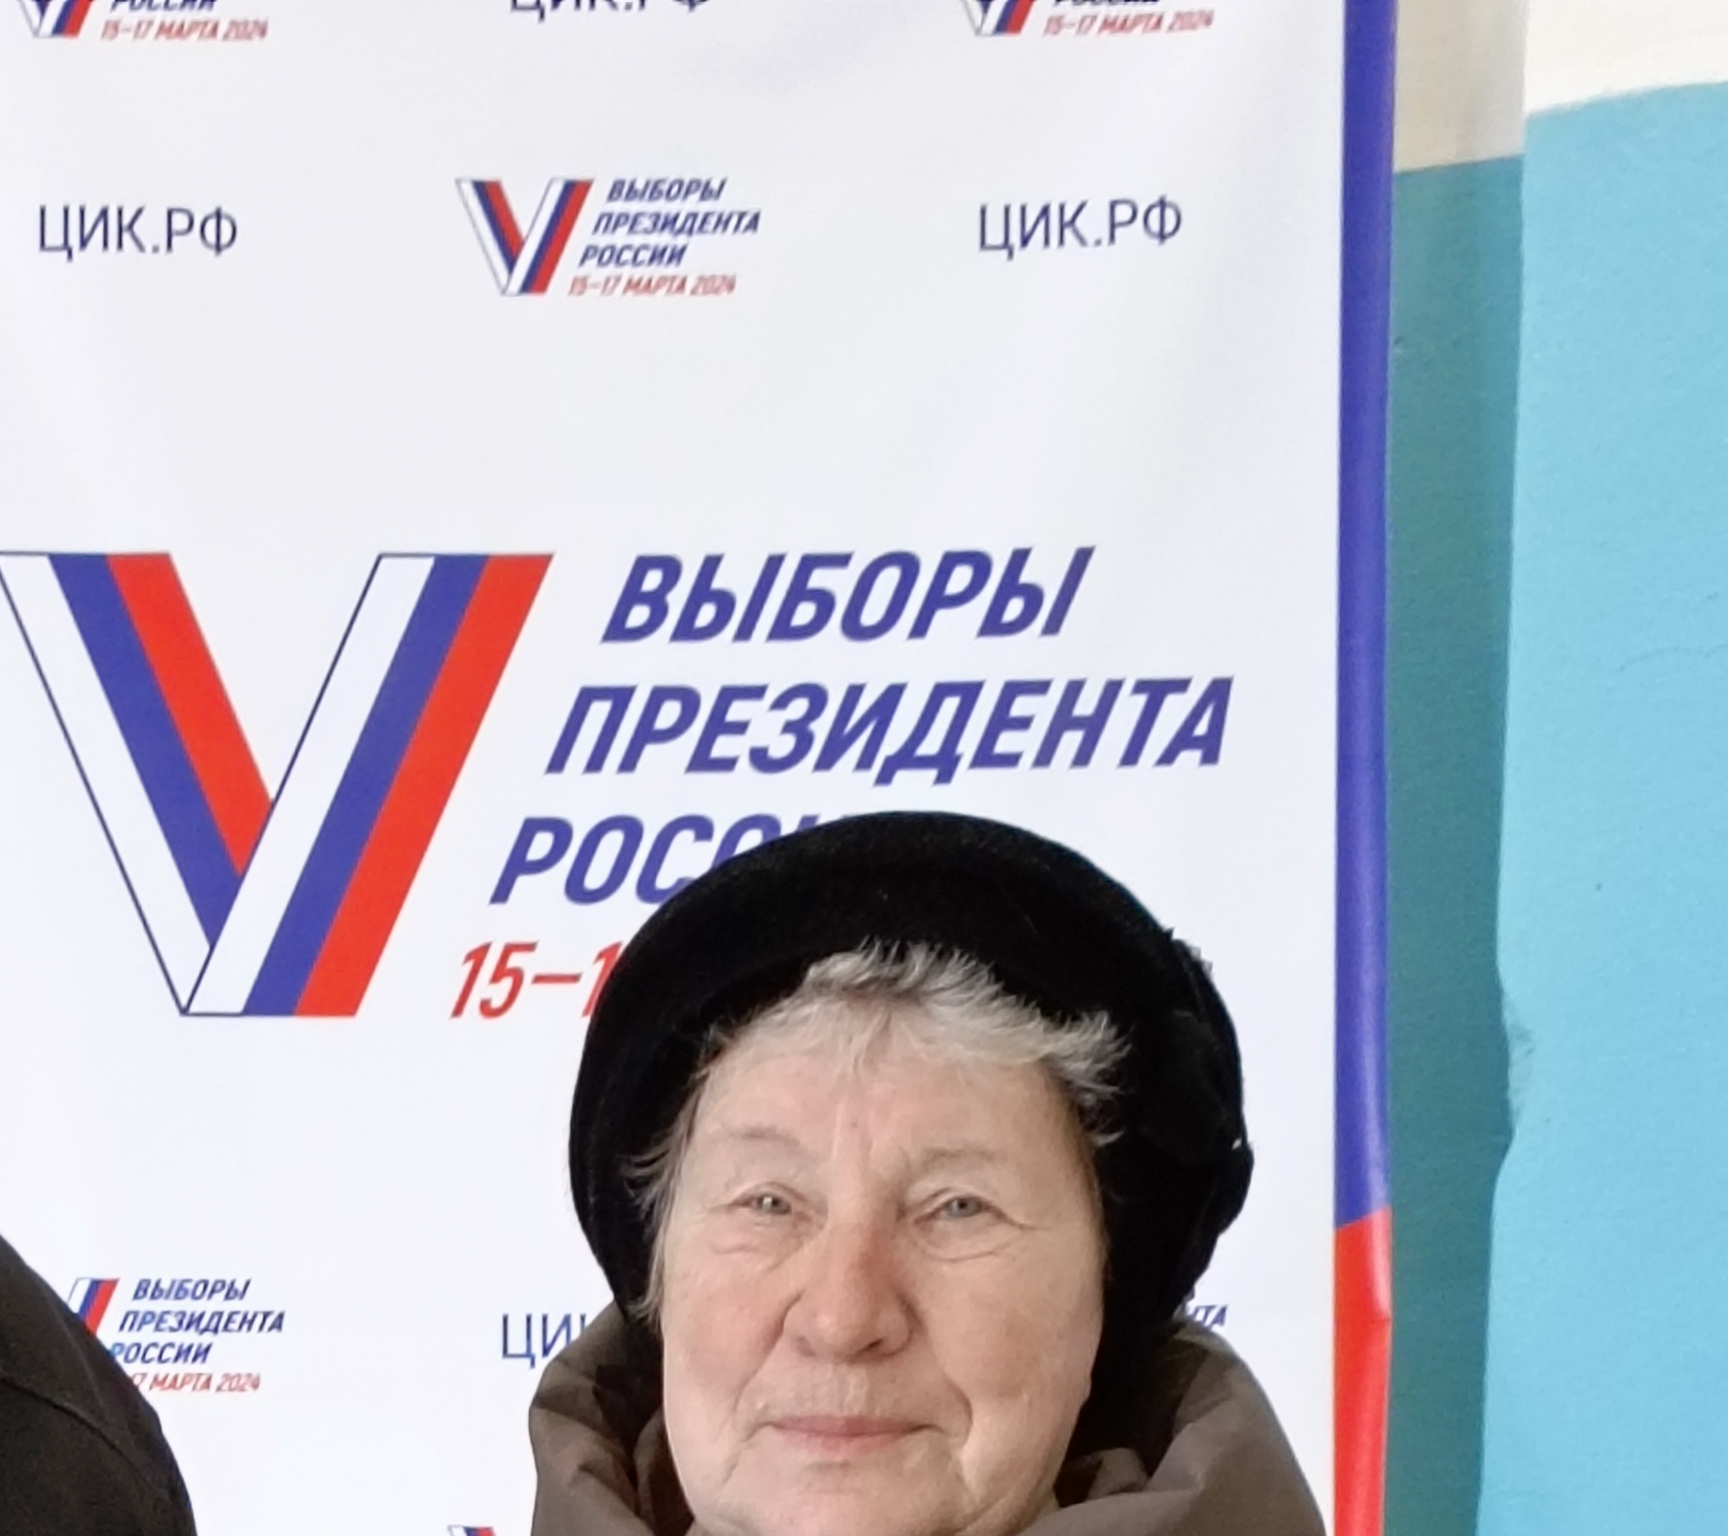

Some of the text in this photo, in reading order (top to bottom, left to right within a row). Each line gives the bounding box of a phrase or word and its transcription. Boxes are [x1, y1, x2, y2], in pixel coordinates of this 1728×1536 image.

[154, 19, 220, 40] МАРТА
[223, 19, 268, 40] 2024
[1097, 12, 1165, 35] МАРТА
[1167, 10, 1214, 32] 2024
[606, 177, 727, 203] ВЫБОРЫ
[38, 204, 238, 262] ЦИК.РФ
[592, 209, 761, 237] ПРЕЗИДЕНТА
[978, 194, 1183, 262] ЦИК.РФ
[578, 243, 688, 268] РОССИИ
[623, 273, 688, 296] МАРТА
[690, 273, 736, 296] 2024
[600, 545, 1096, 645] ВЫБОРЫ
[543, 675, 1235, 787] ПРЕЗИДЕНТА
[133, 1278, 251, 1301] ВЫБОРЫ
[119, 1310, 285, 1335] ПРЕЗИДЕНТА
[149, 1373, 212, 1391] МАРТА
[216, 1373, 261, 1392] 2024
